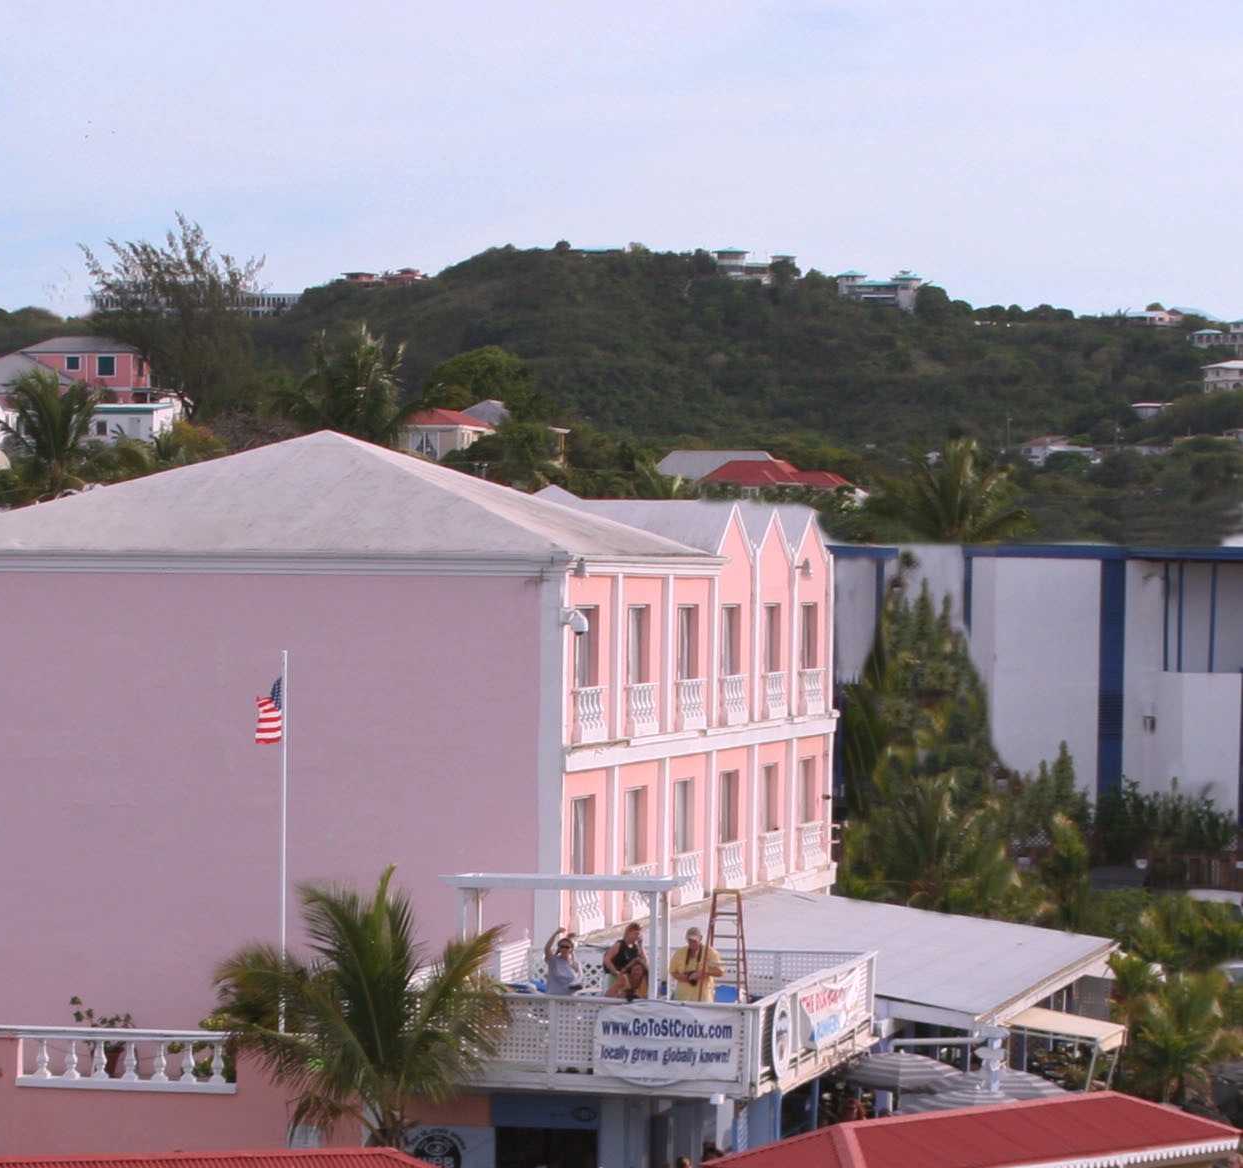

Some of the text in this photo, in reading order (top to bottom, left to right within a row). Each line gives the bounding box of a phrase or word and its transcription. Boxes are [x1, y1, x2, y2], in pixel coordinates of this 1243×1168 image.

[602, 1018, 733, 1039] www.GoToStCroix.com
[600, 1044, 630, 1064] locally
[631, 1047, 659, 1063] grown
[662, 1047, 697, 1065] globally
